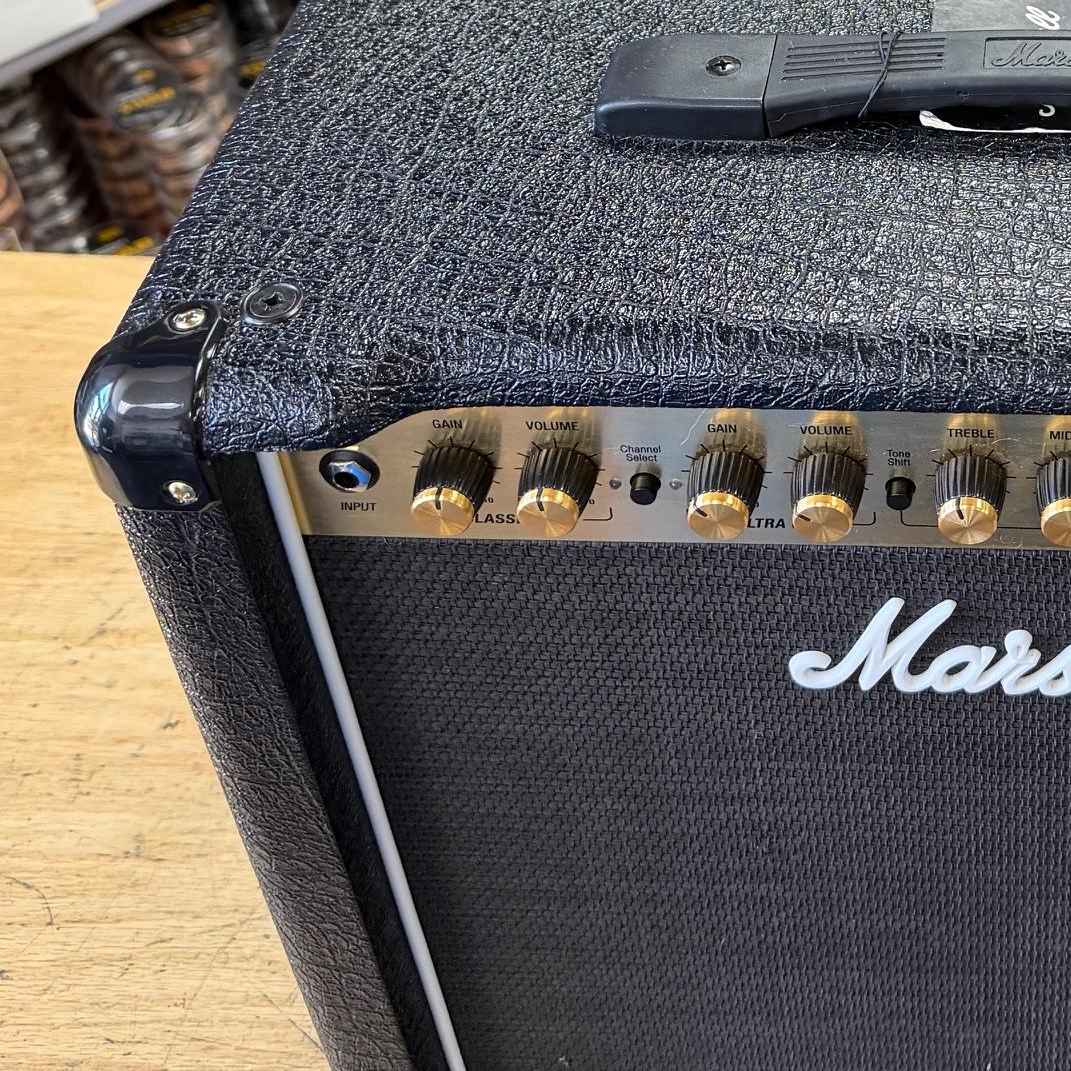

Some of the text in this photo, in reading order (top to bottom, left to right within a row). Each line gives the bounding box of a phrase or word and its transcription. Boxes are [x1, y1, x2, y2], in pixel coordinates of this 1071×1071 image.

[432, 418, 463, 430] GAIN
[525, 420, 579, 432] VOLUME
[707, 423, 737, 434] GAIN
[799, 425, 852, 437] VOLUME
[947, 428, 995, 439] TREBLE
[620, 444, 662, 455] Channel
[887, 449, 911, 458] Tone
[625, 453, 658, 463] Select
[887, 457, 912, 467] Shift
[340, 502, 376, 512] INPUT
[747, 517, 786, 529] LTRA
